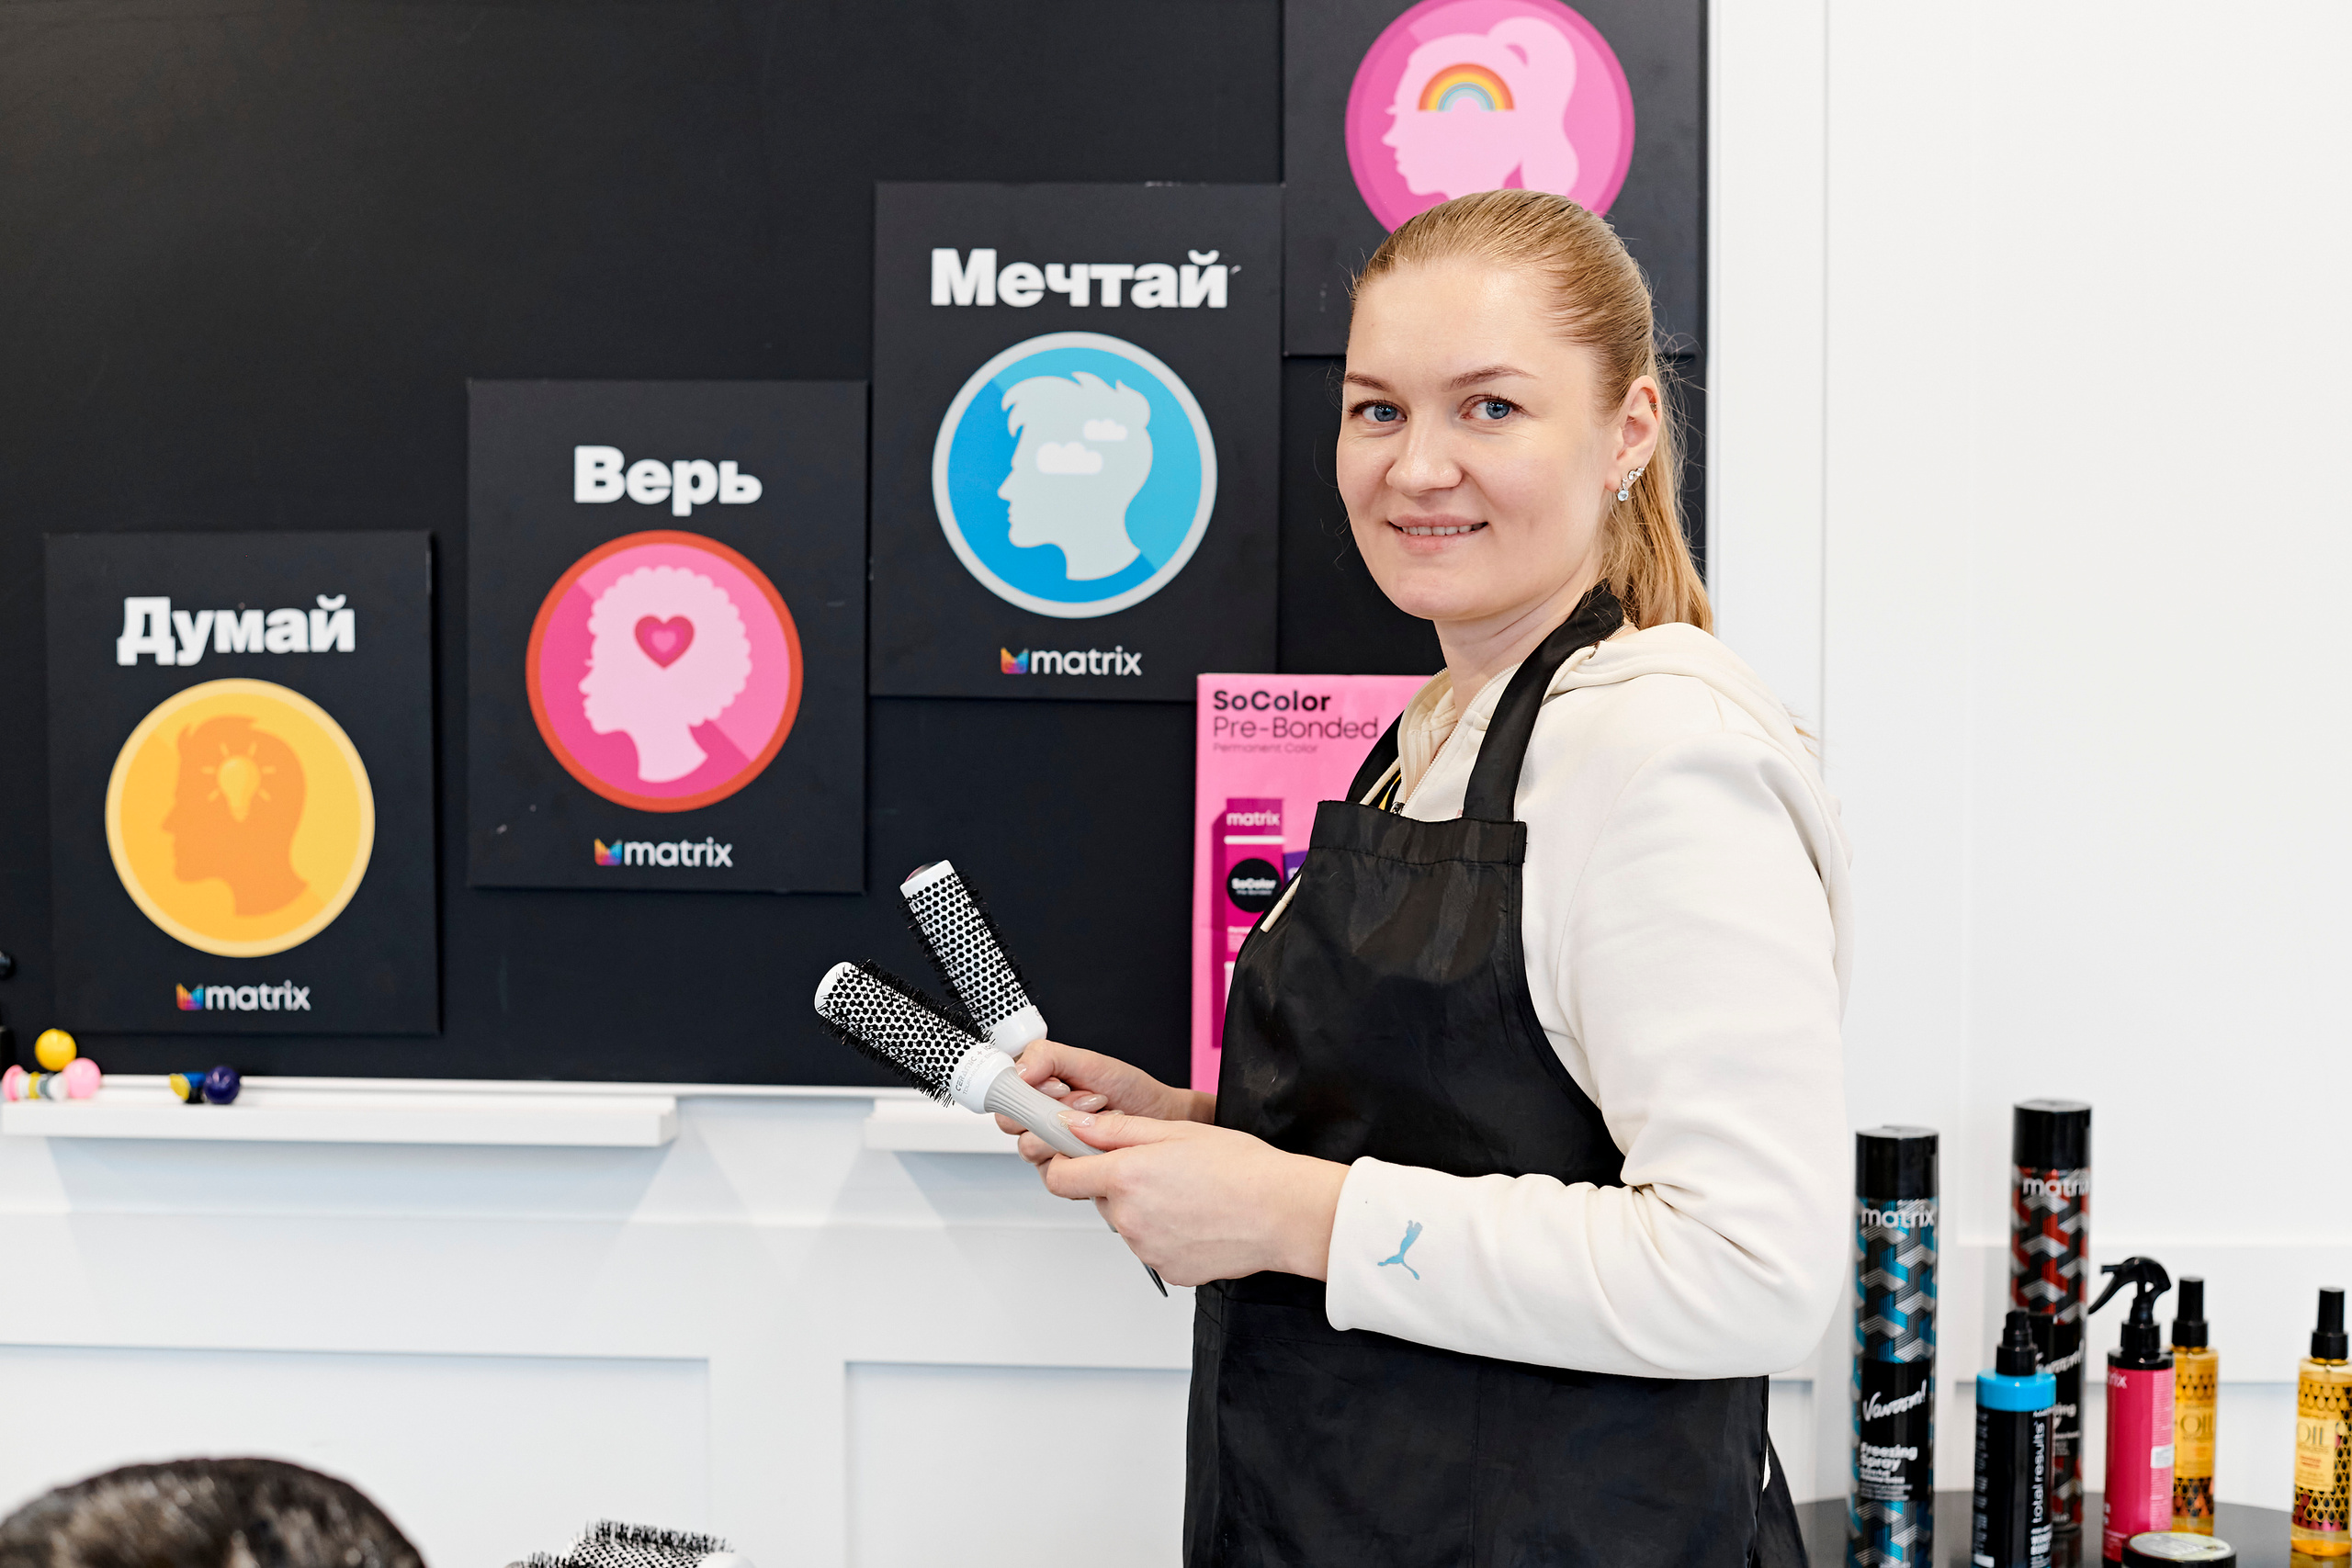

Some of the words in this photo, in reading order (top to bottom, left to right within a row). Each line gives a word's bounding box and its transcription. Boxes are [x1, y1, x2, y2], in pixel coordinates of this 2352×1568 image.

[932, 248, 1227, 309] Мечтай
[573, 446, 763, 516] Верь
[117, 594, 356, 666] Думай
[1030, 645, 1142, 676] matrix
[1214, 690, 1331, 711] SoColor
[1214, 716, 1378, 739] Pre-Bonded
[1214, 743, 1281, 753] Permanent
[1285, 743, 1317, 753] Color
[1227, 809, 1280, 826] matrix
[624, 836, 733, 868] matrix
[204, 979, 311, 1011] matrix
[1861, 1206, 1934, 1228] matrix
[2031, 1422, 2045, 1483] results
[2031, 1483, 2044, 1524] total
